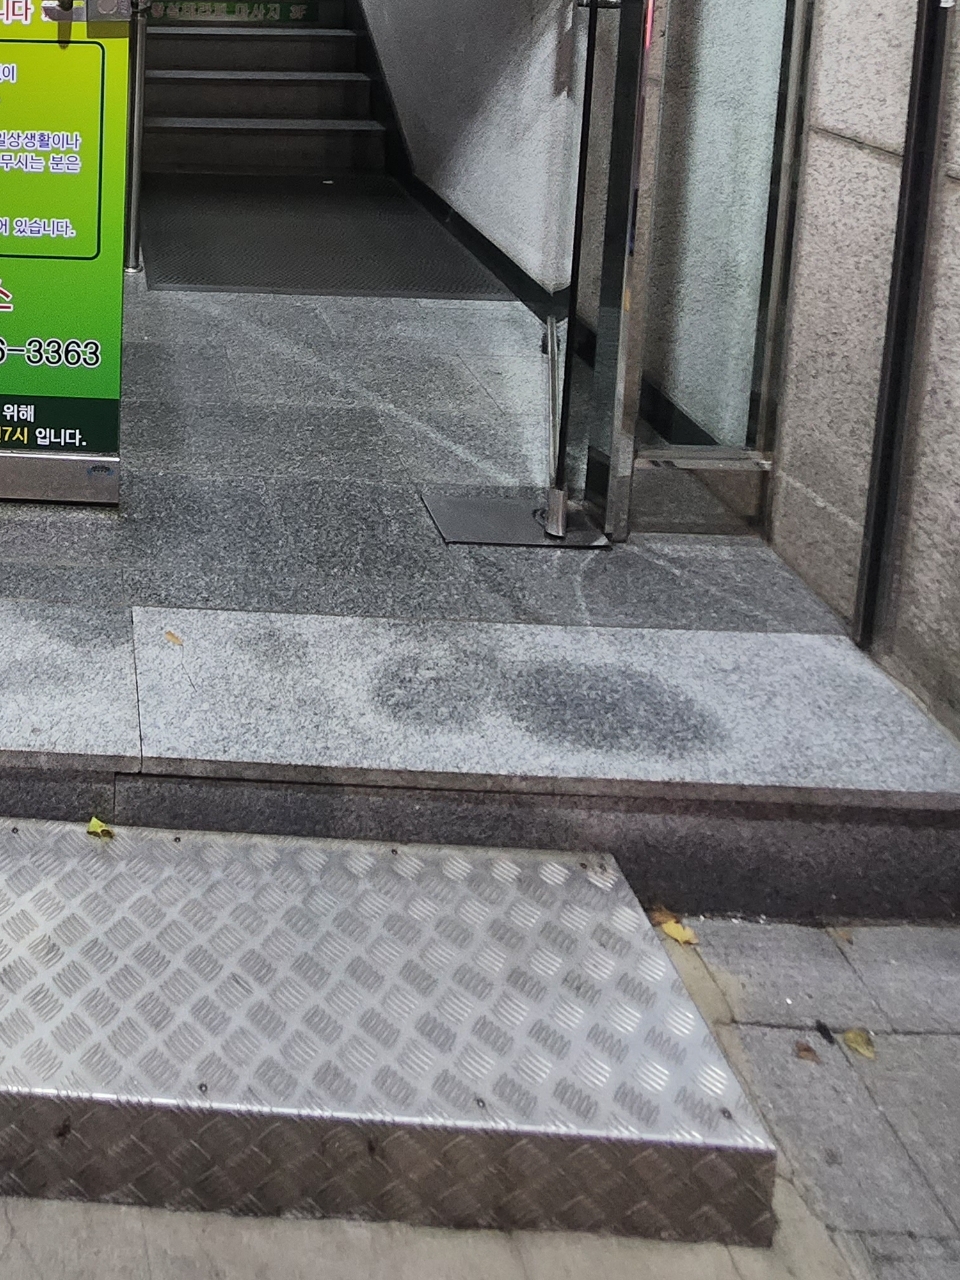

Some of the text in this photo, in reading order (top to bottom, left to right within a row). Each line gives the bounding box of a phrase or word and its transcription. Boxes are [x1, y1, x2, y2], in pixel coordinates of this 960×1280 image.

[49, 154, 81, 171] 분은
[13, 218, 76, 237] 있습니다.
[2, 403, 36, 423] 위해
[34, 427, 88, 447] 입니다.
